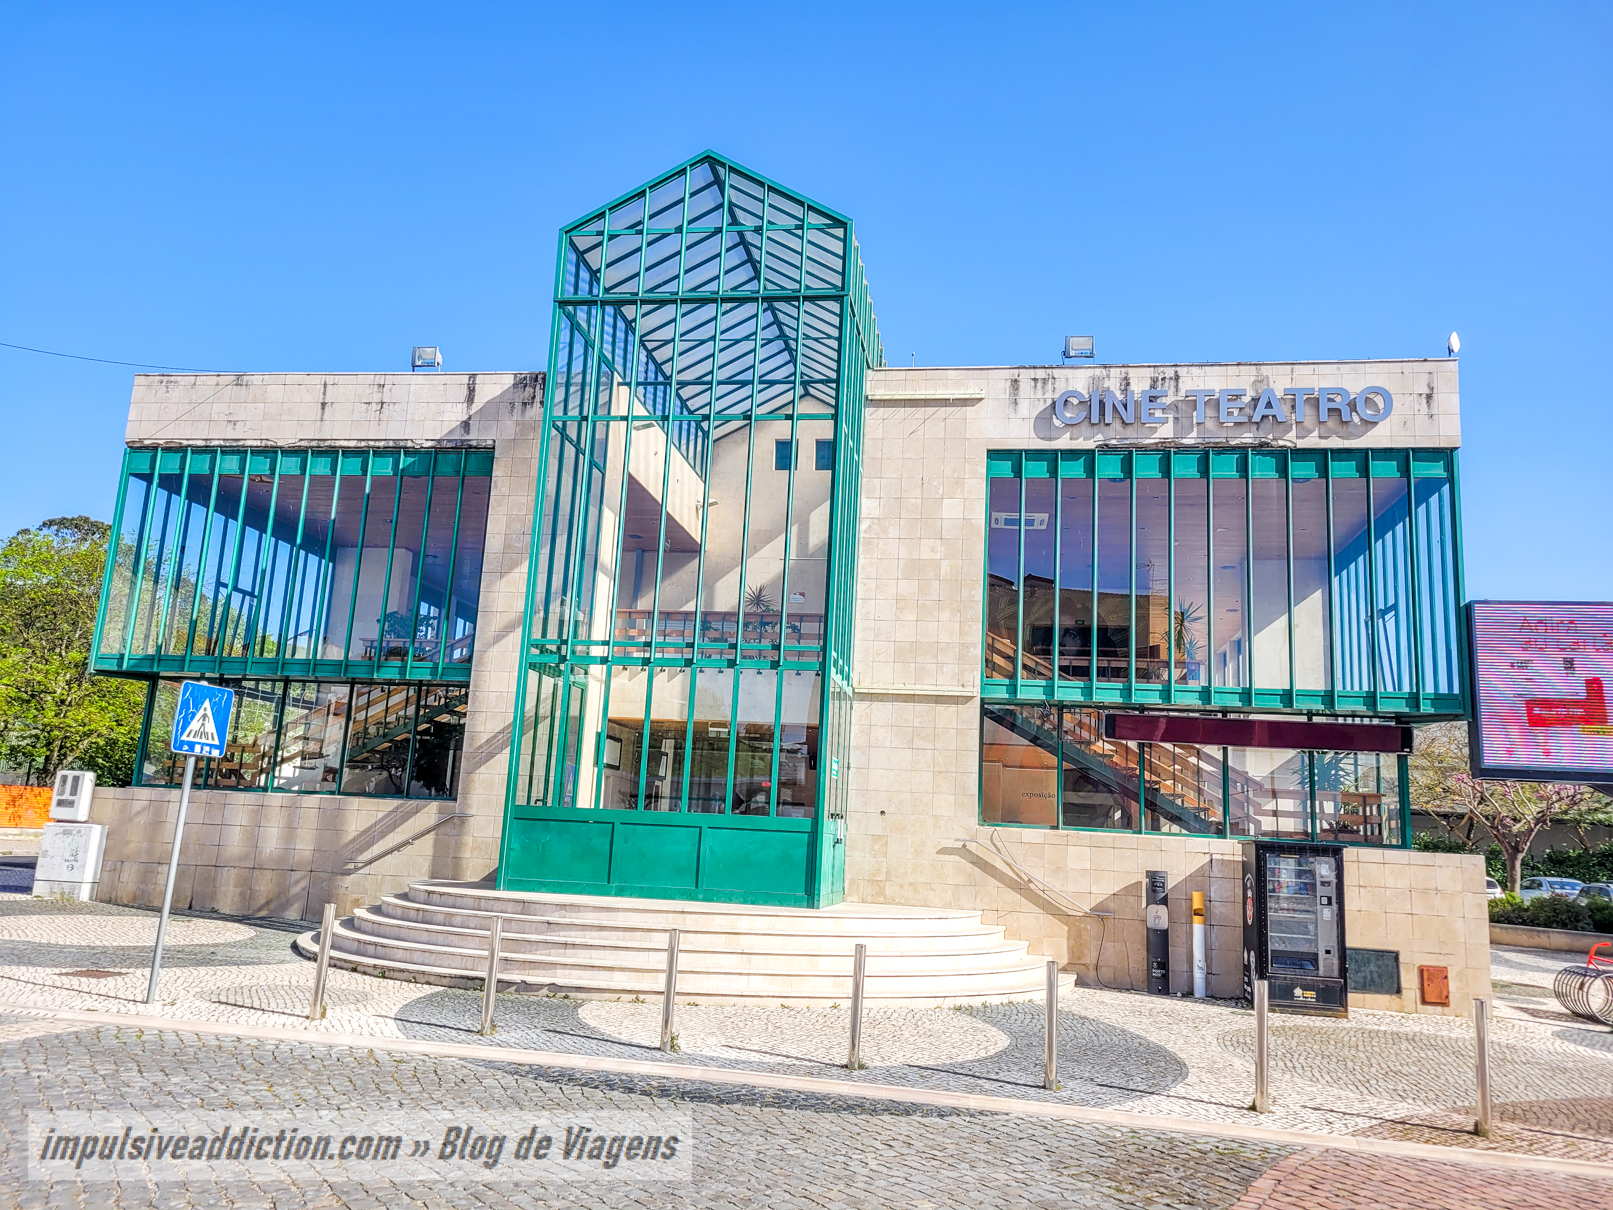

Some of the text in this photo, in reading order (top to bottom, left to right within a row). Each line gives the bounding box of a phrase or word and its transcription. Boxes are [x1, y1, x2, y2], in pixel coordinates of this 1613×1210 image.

[1055, 385, 1394, 425] CINE TEATRO
[1021, 791, 1056, 799] exposição
